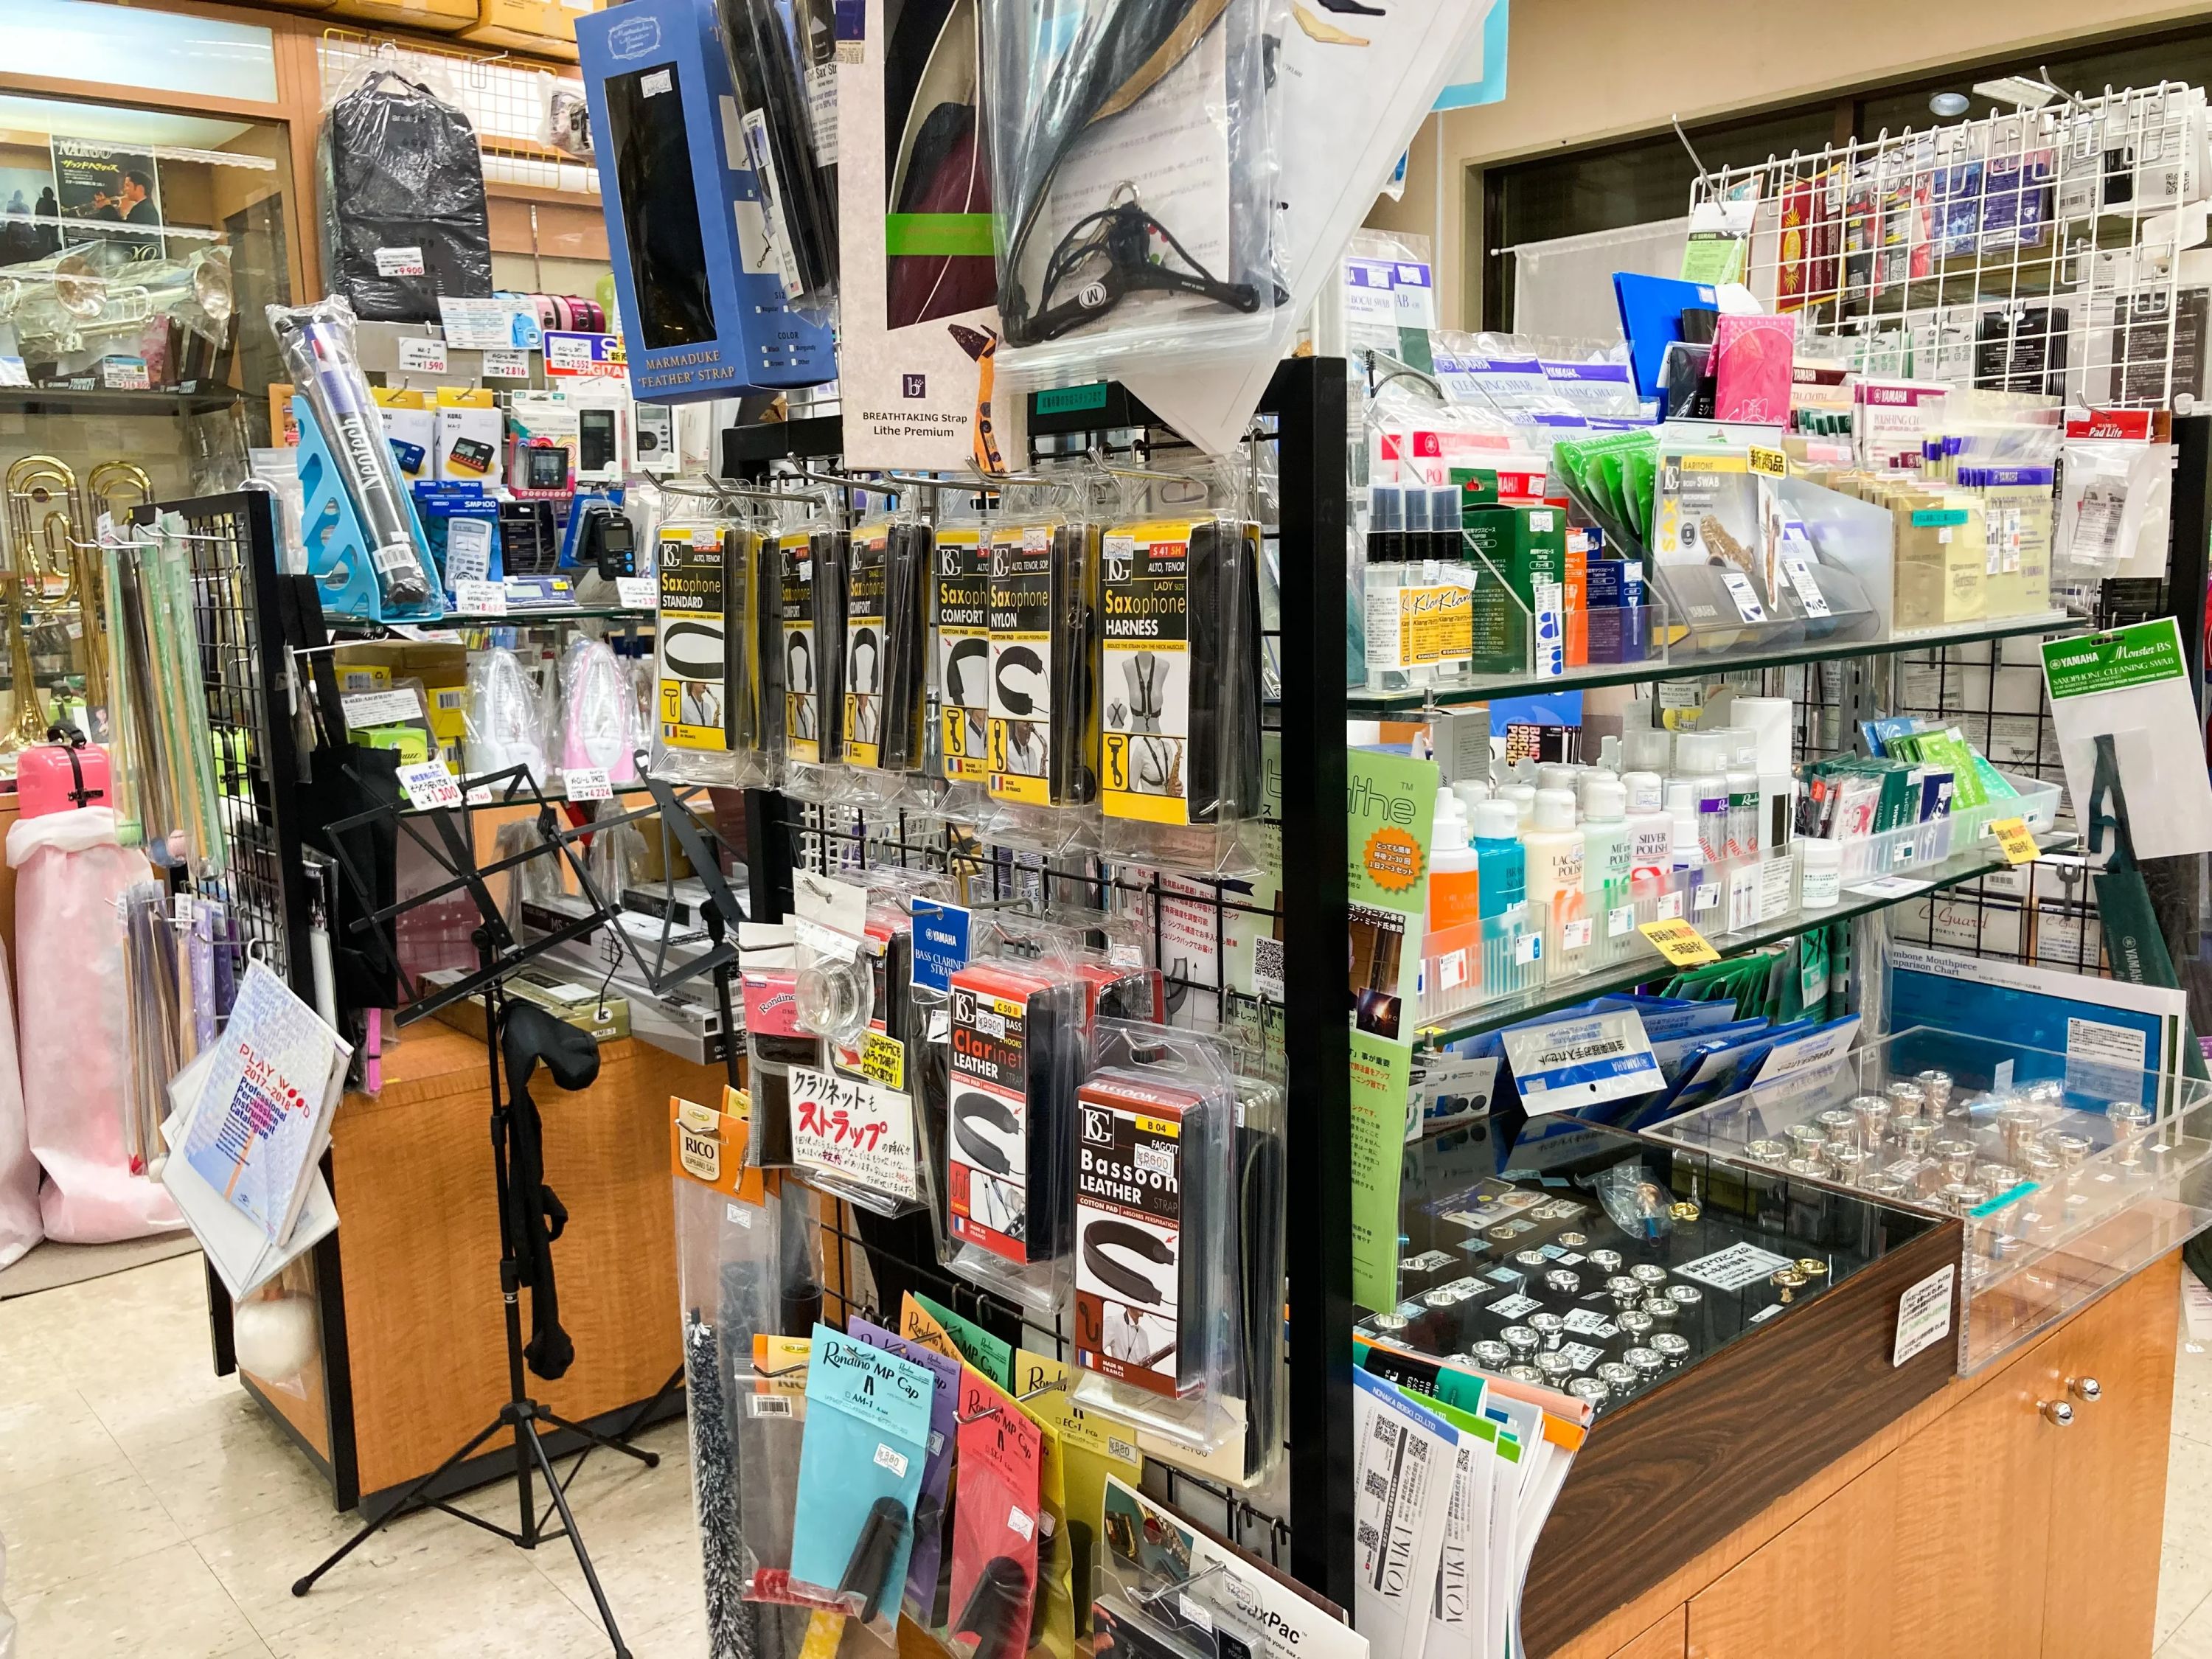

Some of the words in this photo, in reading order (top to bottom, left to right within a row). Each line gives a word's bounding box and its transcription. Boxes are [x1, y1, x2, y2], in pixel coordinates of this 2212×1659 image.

[778, 331, 799, 339] COLOR
[646, 350, 720, 369] MARMADUKE
[698, 366, 734, 381] STRAP
[1793, 369, 1817, 382] YAMAHA
[1505, 380, 1533, 392] SWAB
[1881, 390, 1907, 403] YAMAHA
[863, 412, 939, 422] BREATHTAKING
[942, 414, 967, 425] Strap
[874, 425, 901, 436] Lithe
[904, 427, 954, 437] Premium
[2089, 427, 2104, 437] Pad
[2105, 427, 2123, 437] Life
[1750, 449, 1784, 473] 新商品
[1697, 476, 1719, 487] SWAB
[1662, 498, 1679, 552] SAX
[662, 543, 681, 567] BG
[1153, 546, 1158, 556] S
[1160, 546, 1169, 556] 41
[1171, 546, 1182, 555] SH
[940, 549, 962, 576] BG
[993, 548, 1010, 577] BG
[1148, 562, 1164, 574] ALTO,
[1165, 561, 1186, 572] TENOR
[662, 572, 721, 596] Saxophone
[850, 577, 885, 601] Saxophone
[1154, 581, 1174, 591] LADY
[662, 595, 703, 608] STANDARD
[991, 582, 1048, 613] Saxophone
[1105, 589, 1186, 620] Saxophone
[783, 605, 800, 618] COMFORT
[850, 601, 871, 614] COMFORT
[941, 608, 984, 625] COMFORT
[991, 612, 1018, 627] NYLON
[1105, 619, 1159, 636] HARNESS
[2060, 652, 2099, 669] YAMAHA
[2109, 644, 2155, 664] Monster
[2156, 641, 2171, 653] BS
[2053, 669, 2102, 686] SAXOPHONE
[2103, 661, 2149, 676] CLEANING
[2149, 656, 2174, 668] SWAB
[2065, 680, 2087, 689] BARITONE
[1507, 725, 1519, 767] POCKE
[1529, 726, 1540, 760] BAND
[1402, 782, 1414, 791] TM
[1891, 804, 1899, 830] AMAHA
[1639, 832, 1666, 843] SILVER
[1376, 841, 1411, 855] とっても簡単
[1635, 844, 1668, 855] POLISH
[1919, 903, 1989, 930] C-Guard
[933, 930, 957, 947] YAMAHA
[915, 948, 931, 962] BASS
[1926, 954, 1978, 971] Mouthpiece
[1934, 965, 1960, 977] Chart
[2124, 948, 2143, 986] YAMAH
[955, 992, 977, 1023] BG
[1004, 1004, 1012, 1013] 50
[978, 1017, 1002, 1033] ¥9900
[1006, 1018, 1023, 1032] BASS
[954, 1029, 1023, 1069] Clarinet
[240, 1043, 275, 1077] PLAY
[954, 1051, 998, 1079] LEATHER
[1611, 1056, 1640, 1072] YAMAHA
[951, 1074, 970, 1084] COTTON
[240, 1076, 287, 1122] Professional
[793, 1071, 877, 1113] クラリネットも
[1088, 1082, 1157, 1102] BASSOON
[233, 1094, 275, 1135] Instrument
[237, 1085, 279, 1127] Percussion
[230, 1103, 268, 1140] Catalogue
[799, 1102, 888, 1152] ストラップ
[1084, 1108, 1113, 1142] BG
[1148, 1121, 1153, 1130] B
[1155, 1122, 1166, 1133] 04
[685, 1136, 714, 1160] RICO
[1151, 1139, 1179, 1155] FAGOTT
[685, 1155, 706, 1170] SOPRANO
[706, 1164, 715, 1173] SAX
[1138, 1151, 1169, 1169] ¥6600
[1081, 1148, 1178, 1194] Bassoon
[1080, 1174, 1142, 1205] LEATHER
[1153, 1197, 1178, 1213] STRAP
[1080, 1197, 1105, 1210] COTTON
[1105, 1203, 1119, 1214] PAD
[1122, 1210, 1144, 1220] ABSORBS
[1145, 1214, 1178, 1230] PERSPIRATION
[970, 1223, 980, 1231] MADE
[970, 1230, 986, 1240] FRANCE
[961, 1340, 978, 1357] MP
[981, 1354, 999, 1382] Cap
[1102, 1360, 1116, 1369] MADE
[824, 1341, 872, 1371] Rondino
[874, 1365, 894, 1380] MP
[897, 1376, 919, 1399] Cap
[1102, 1367, 1124, 1377] FRANCE
[852, 1394, 874, 1409] AM-1
[1372, 1386, 1397, 1405] NONAKA
[1397, 1402, 1414, 1419] BOEKI
[1062, 1417, 1082, 1432] EC-1
[1003, 1418, 1017, 1436] MP
[1018, 1433, 1032, 1459] Cap
[1110, 1439, 1130, 1455] ¥880
[1383, 1525, 1413, 1598] NONAKA
[1445, 1545, 1465, 1623] NONAKA
[1272, 1640, 1285, 1650] your
